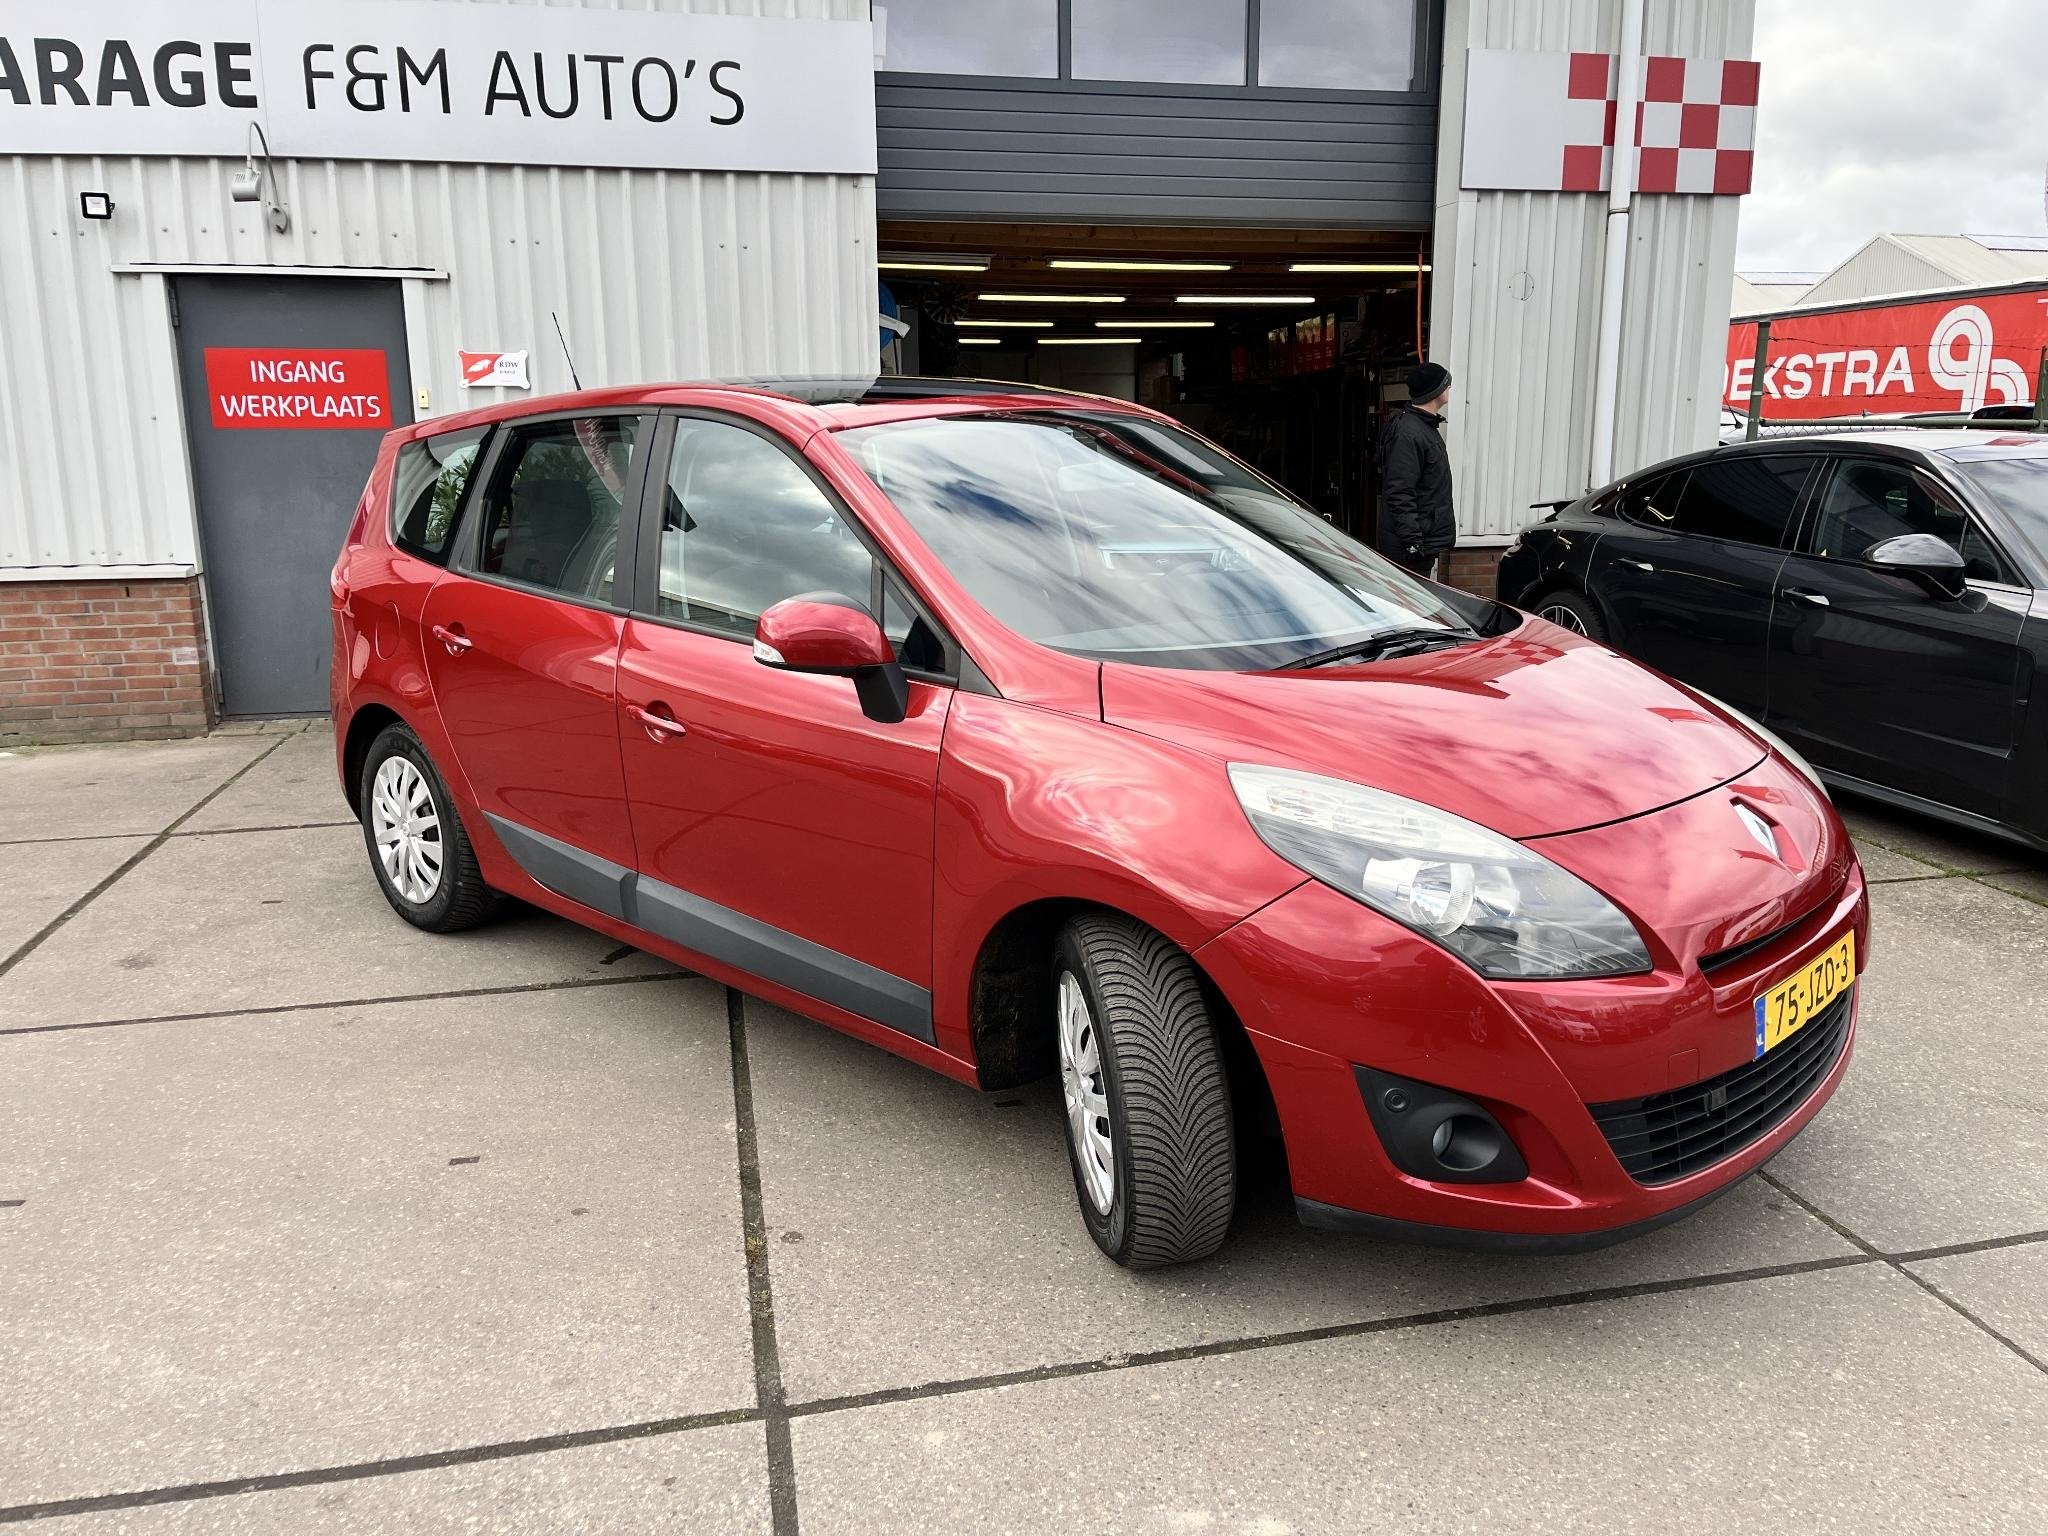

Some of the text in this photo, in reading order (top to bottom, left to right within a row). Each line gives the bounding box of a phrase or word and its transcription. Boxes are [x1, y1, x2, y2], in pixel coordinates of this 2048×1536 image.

[0, 36, 745, 126] ARAGE F&M AUTO'S
[250, 360, 345, 383] INGANG
[1723, 346, 1915, 401] EKSTRA
[220, 395, 381, 418] WERKPLAATS
[1775, 943, 1848, 1036] 75-JZD-3
